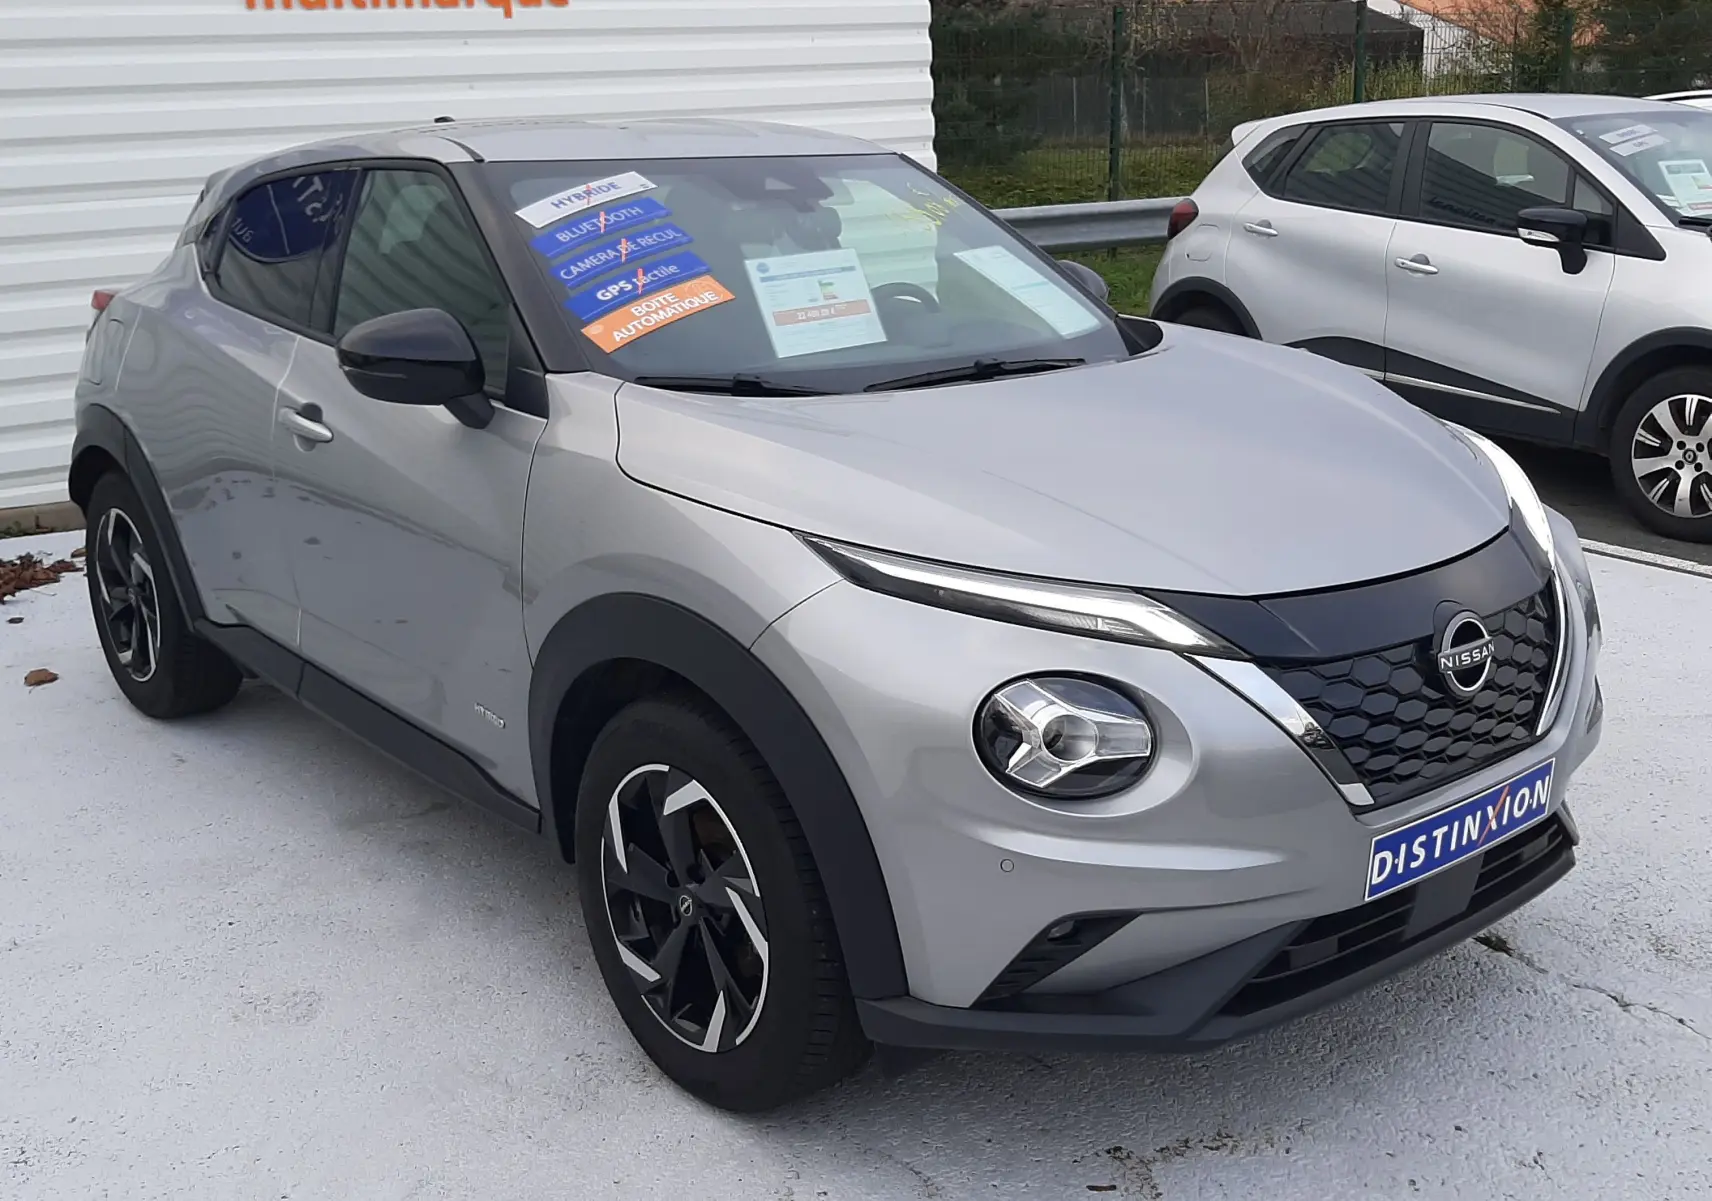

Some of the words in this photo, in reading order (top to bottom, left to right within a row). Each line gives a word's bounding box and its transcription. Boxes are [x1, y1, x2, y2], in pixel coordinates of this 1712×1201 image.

[550, 181, 622, 209] HYBRIDE
[555, 206, 644, 242] BLUETOOTH
[560, 248, 620, 280] CAMERA
[636, 229, 682, 248] RECUL
[596, 280, 633, 301] GPS
[631, 292, 680, 317] BOITE
[612, 290, 719, 342] AUTOMATIQUE
[1440, 640, 1495, 669] NISSAN
[1371, 774, 1550, 886] DISTINXION
